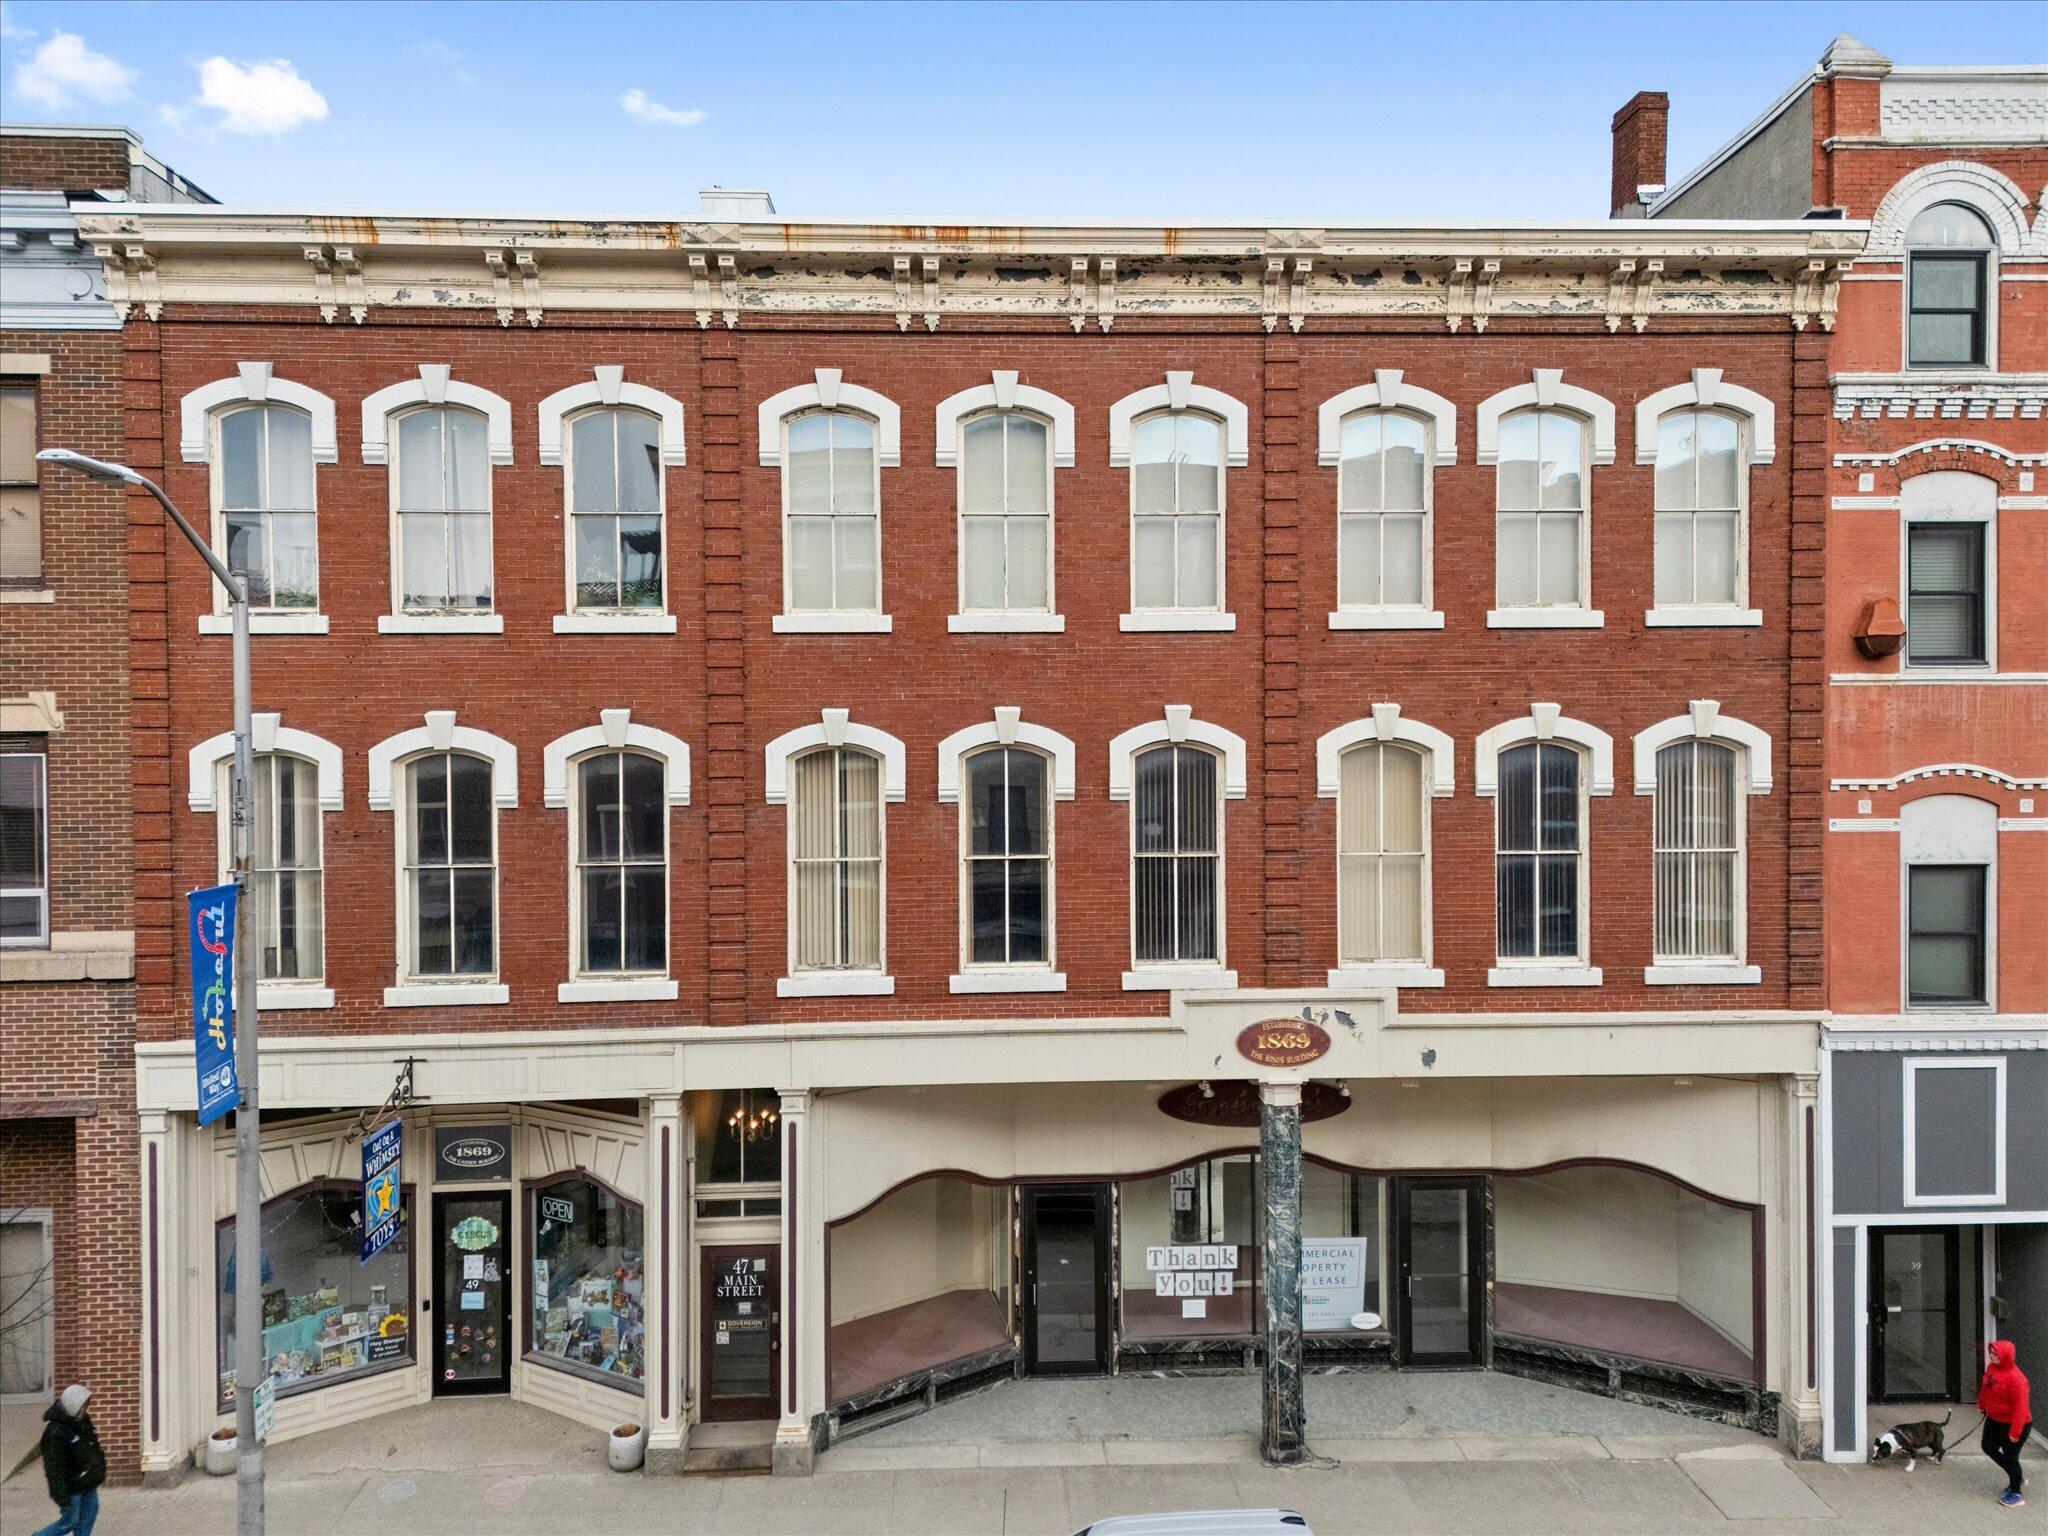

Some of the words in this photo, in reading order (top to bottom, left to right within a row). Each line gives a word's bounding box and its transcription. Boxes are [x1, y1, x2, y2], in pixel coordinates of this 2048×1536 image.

[198, 901, 227, 1050] Hopeful
[1262, 1022, 1305, 1030] ESTABLISHED
[1257, 1033, 1311, 1048] 1869
[1250, 1050, 1263, 1060] THE
[1286, 1049, 1319, 1063] BUILDING
[456, 1146, 492, 1157] 1869
[544, 1200, 573, 1222] OPEN
[371, 1220, 395, 1252] TOYS
[1149, 1248, 1235, 1266] Thank
[733, 1259, 749, 1274] 47
[1911, 1262, 1922, 1270] 39
[466, 1280, 479, 1290] 49
[724, 1275, 757, 1286] MAIN
[1159, 1274, 1228, 1292] you!
[1312, 1277, 1347, 1285] LEASE
[717, 1285, 764, 1297] STREET
